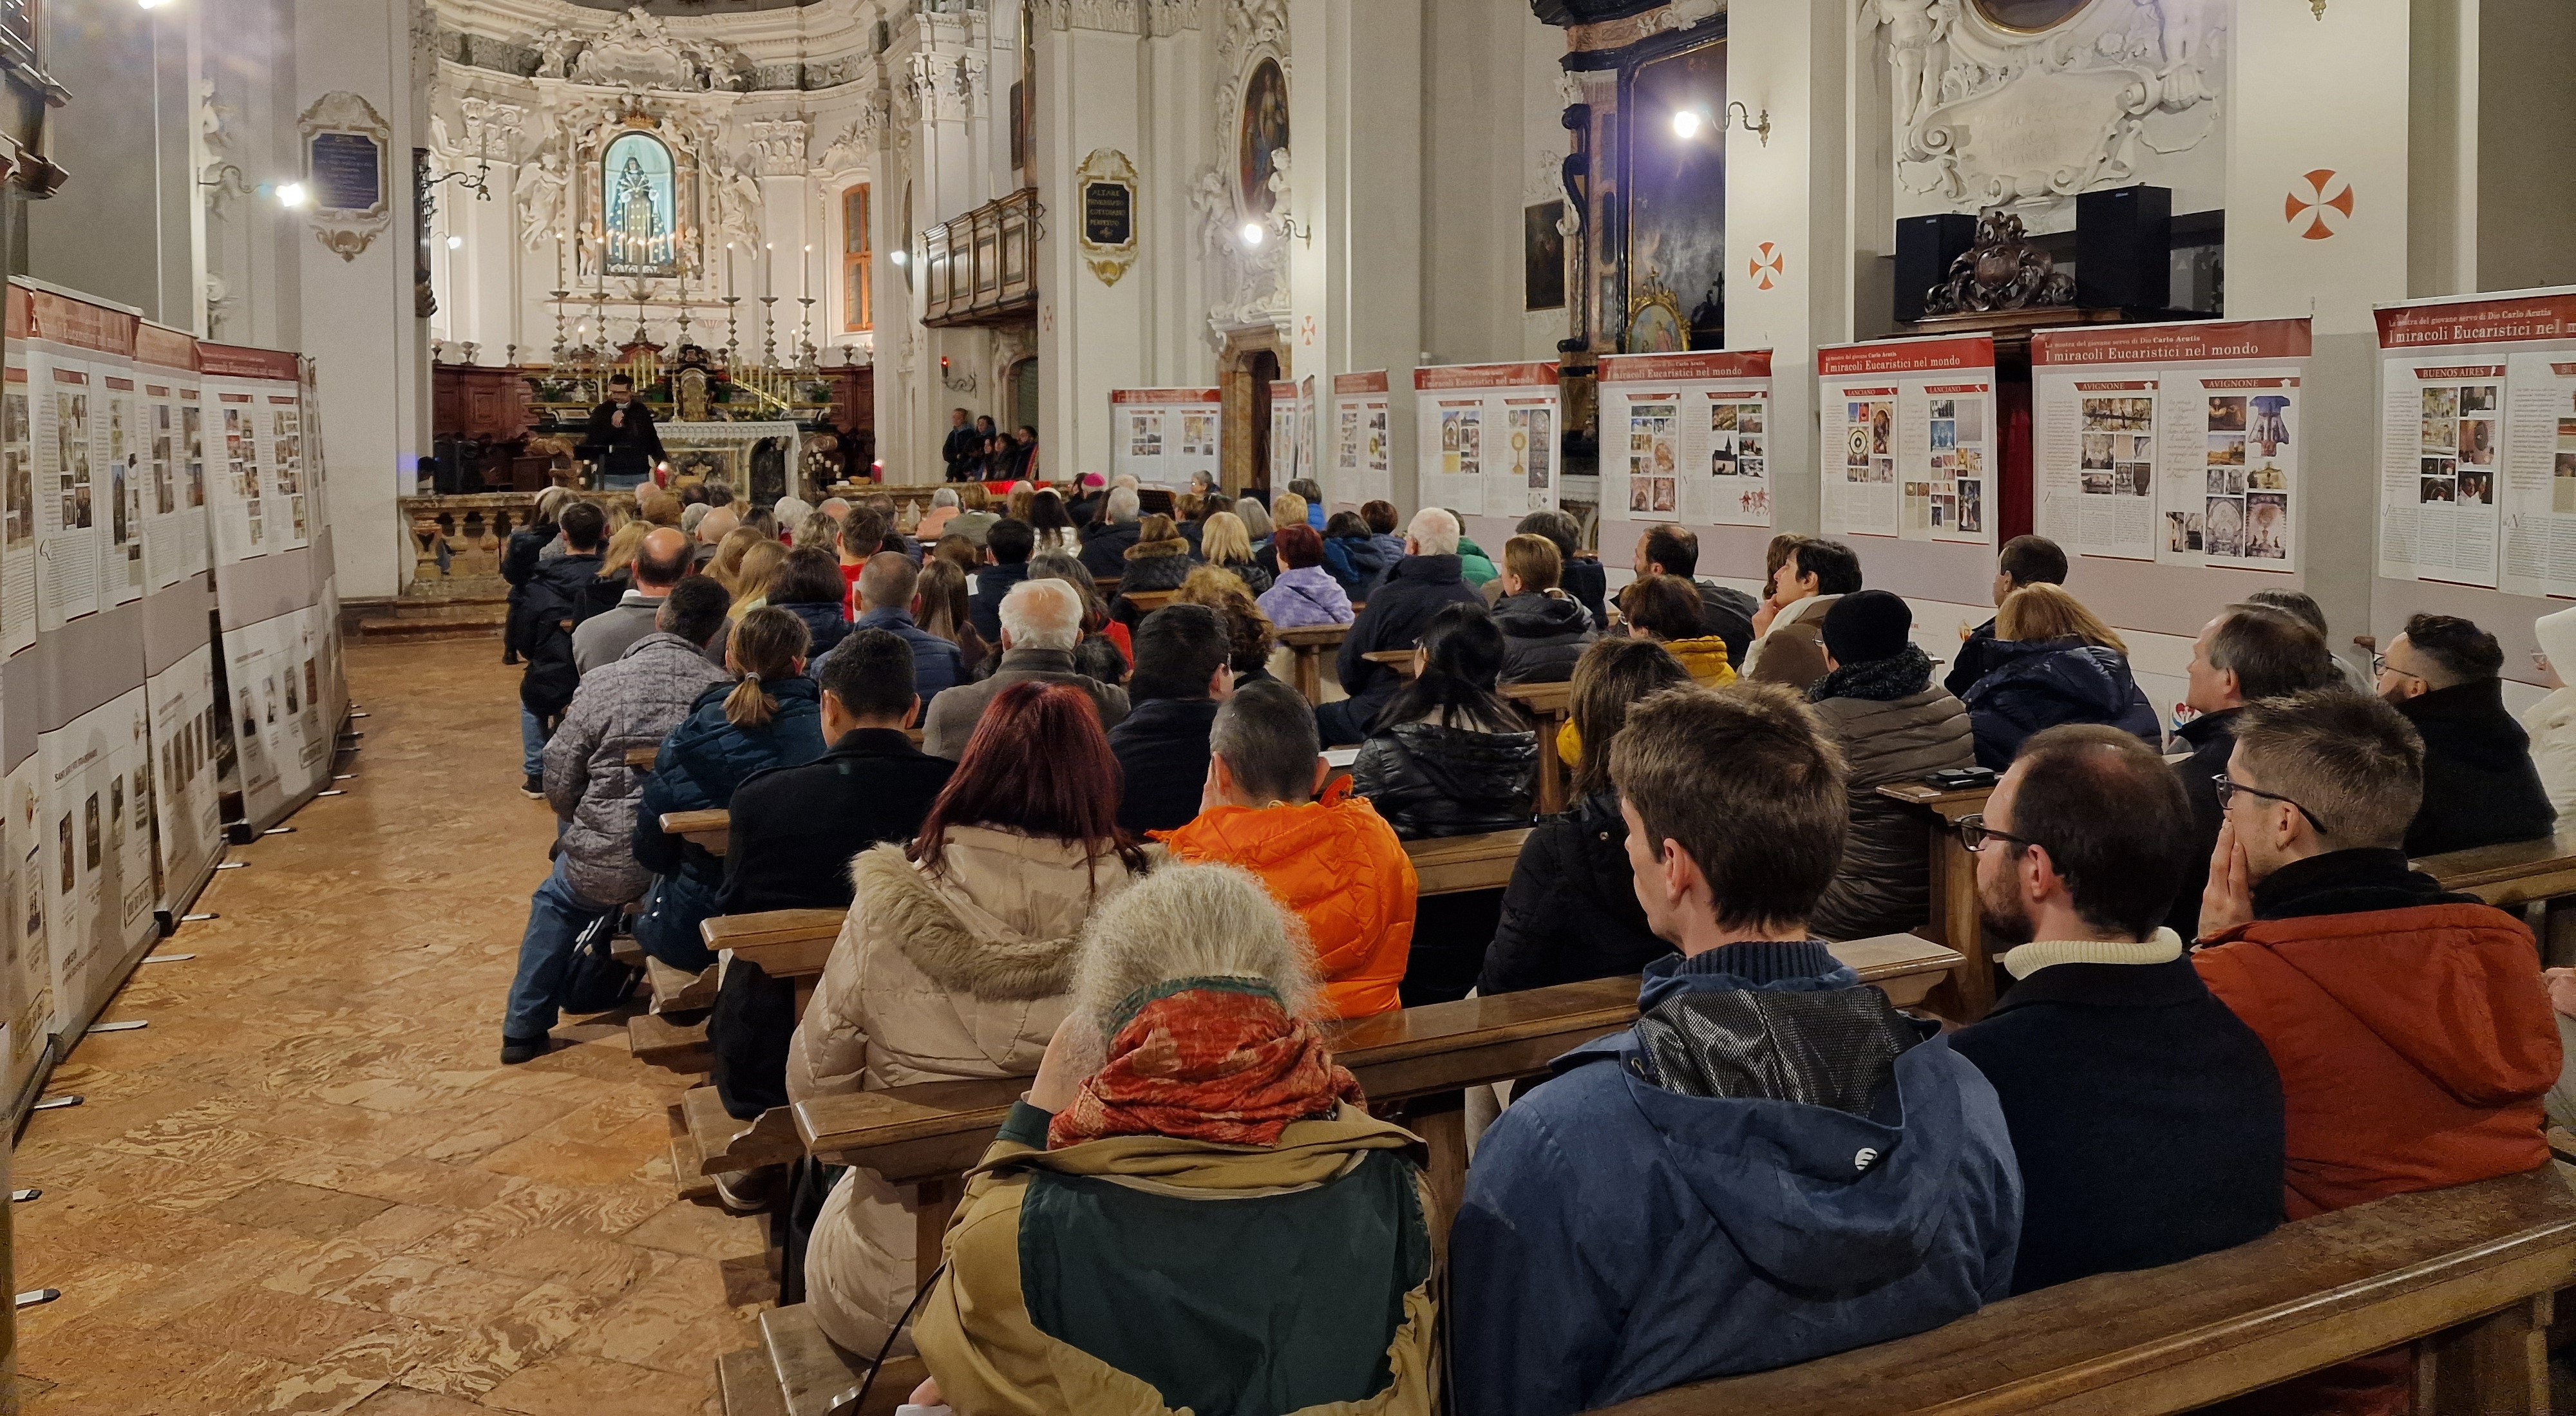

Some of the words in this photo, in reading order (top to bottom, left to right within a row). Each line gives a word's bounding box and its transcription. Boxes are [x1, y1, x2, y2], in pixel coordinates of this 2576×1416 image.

[2419, 316, 2429, 325] del
[2502, 310, 2524, 319] Carlo
[2524, 308, 2552, 317] Acutis
[2389, 330, 2394, 343] I
[2396, 326, 2448, 343] miracoli
[2454, 321, 2530, 339] Eucaristici
[2535, 318, 2561, 334] nel
[2045, 350, 2049, 362] I
[2054, 348, 2103, 361] miracoli
[2108, 345, 2180, 359] Eucaristici
[2185, 344, 2205, 356] nel
[2211, 342, 2259, 355] mondo
[1825, 363, 1828, 372] I
[1830, 361, 1862, 372] miracoli
[1866, 357, 1910, 370] Eucaristici
[1914, 356, 1927, 367] nel
[1931, 355, 1960, 366] mondo
[1607, 370, 1610, 379] I
[1613, 368, 1645, 379] miracoli
[1647, 368, 1693, 378] Eucaristici
[1696, 367, 1709, 377] nel
[1712, 366, 1742, 376] mondo
[2422, 368, 2458, 378] BUENOS
[2459, 367, 2484, 377] AIRES
